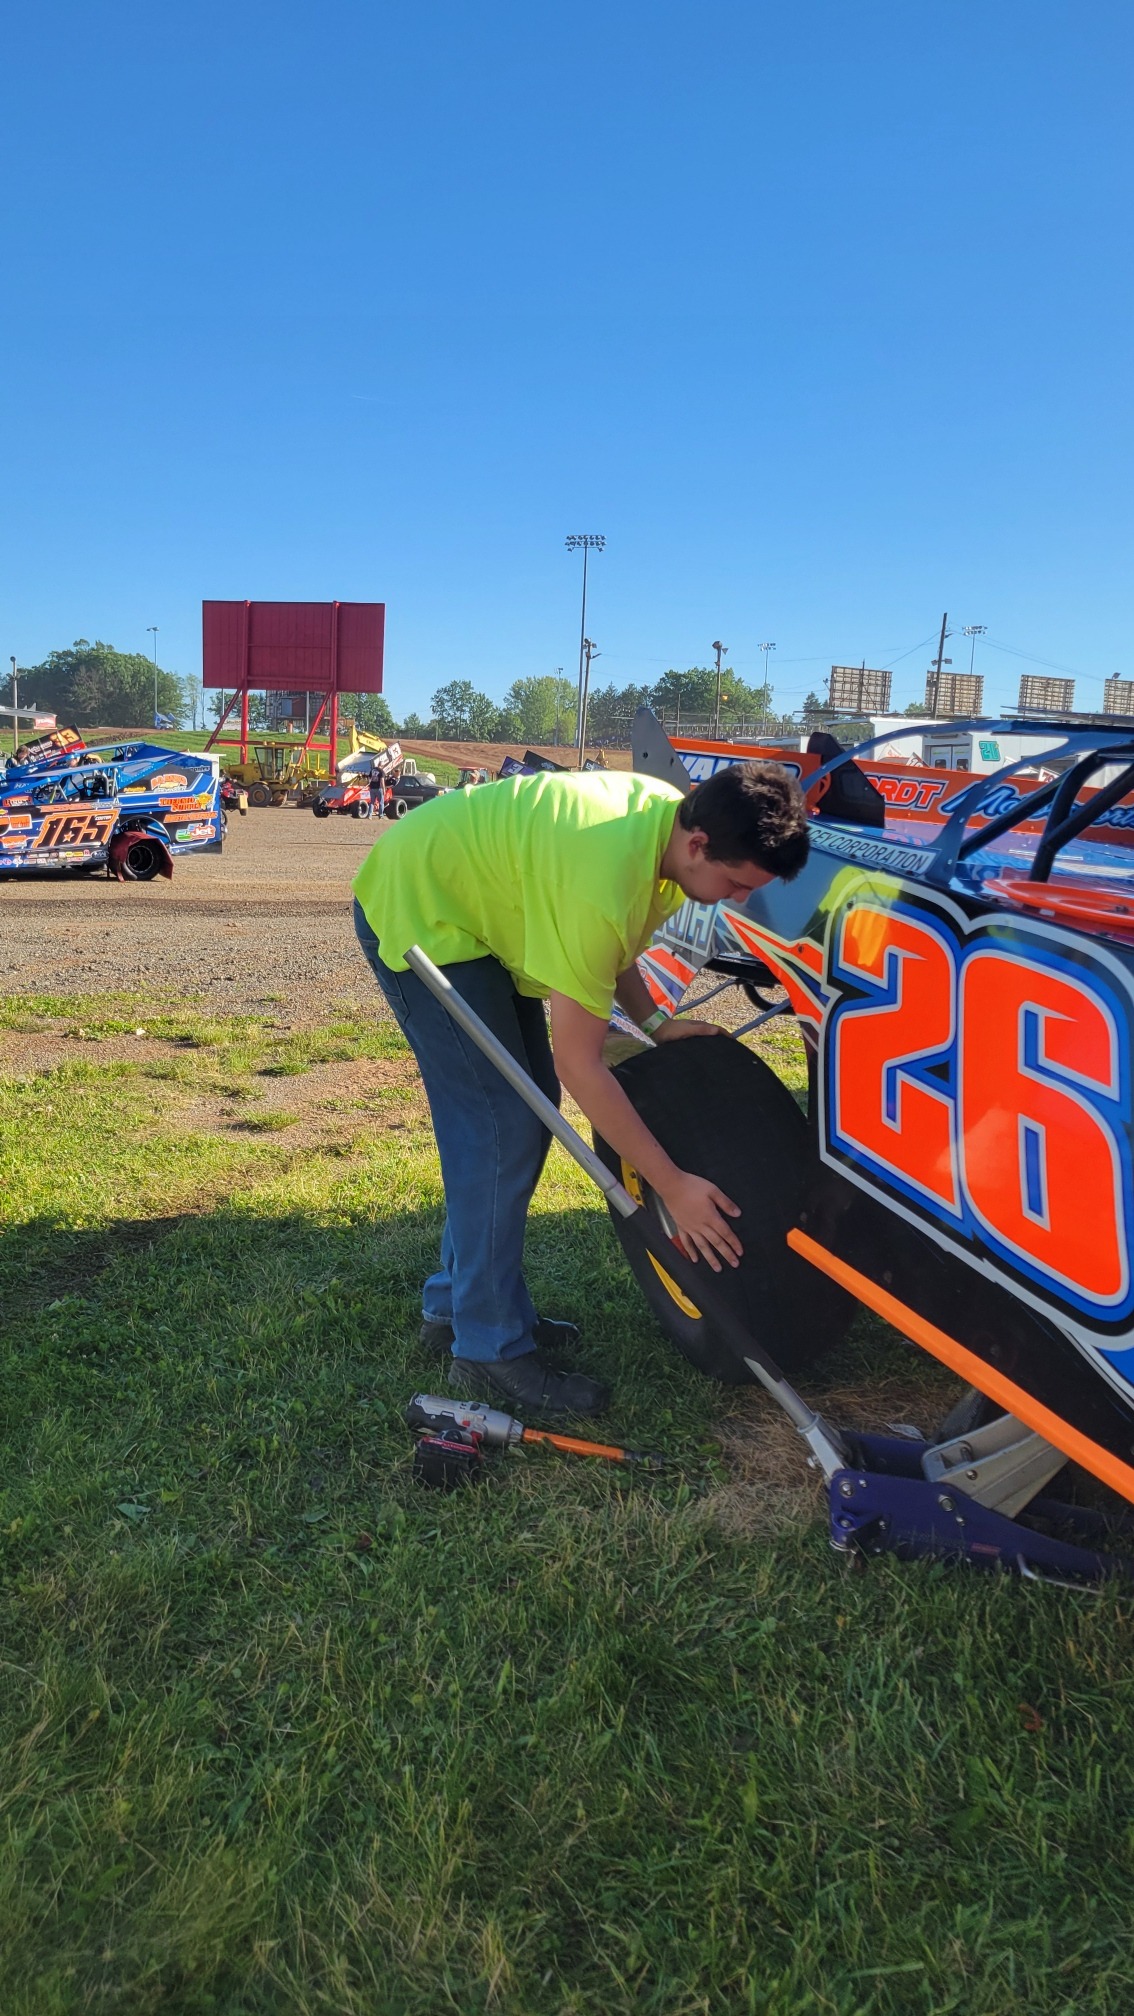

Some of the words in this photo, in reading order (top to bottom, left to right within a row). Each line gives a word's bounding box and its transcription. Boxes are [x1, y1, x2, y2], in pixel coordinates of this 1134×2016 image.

[35, 811, 118, 848] 165
[829, 836, 929, 872] CORPORATION
[836, 903, 1129, 1307] 26
